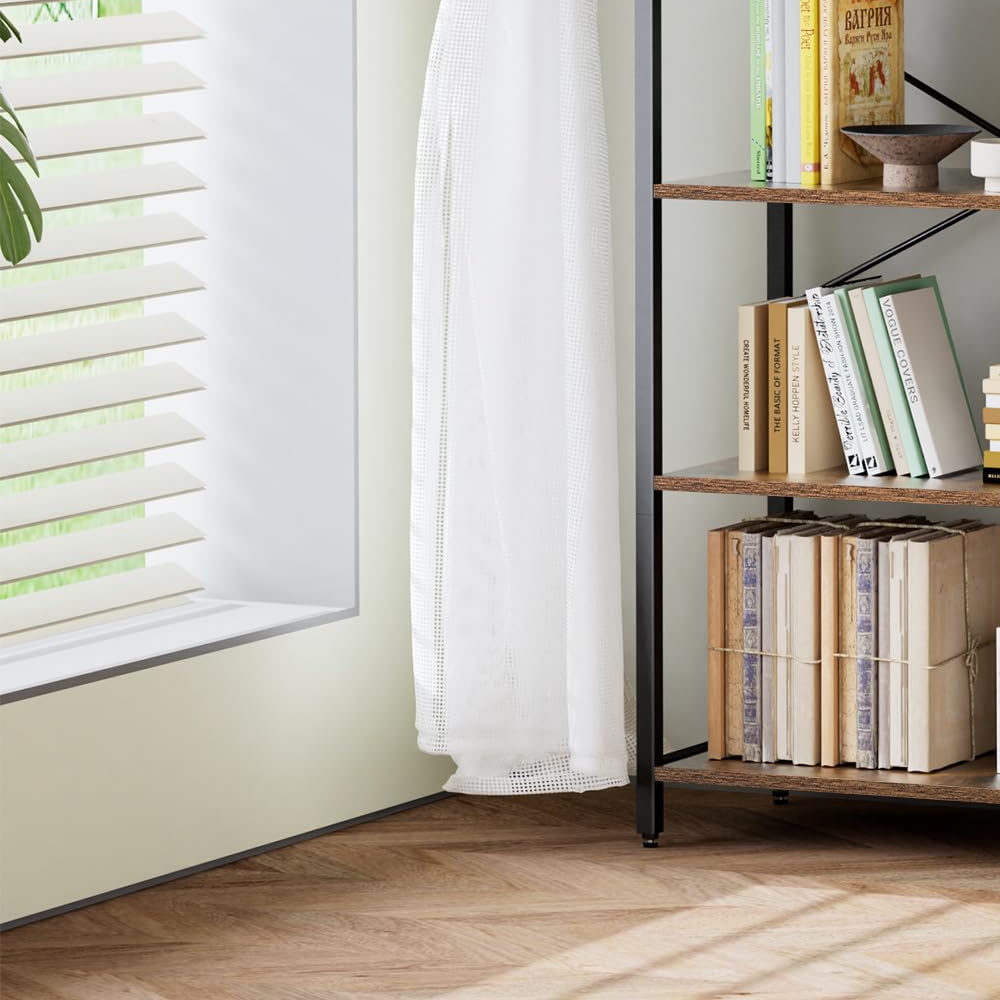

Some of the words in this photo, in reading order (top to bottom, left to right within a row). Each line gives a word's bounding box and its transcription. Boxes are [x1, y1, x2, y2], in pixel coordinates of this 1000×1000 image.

[844, 6, 892, 31] ВАГРИЯ
[801, 28, 814, 50] Poet
[830, 318, 840, 340] SHOW
[792, 345, 800, 373] STYLE
[836, 340, 849, 372] FASHION
[882, 299, 903, 346] VOGUE
[896, 348, 919, 405] COVERS
[774, 376, 781, 388] OF
[792, 375, 800, 413] HOPPEN
[828, 371, 846, 408] Beauty
[846, 374, 859, 411] GRADUATE
[792, 416, 800, 443] KELLY
